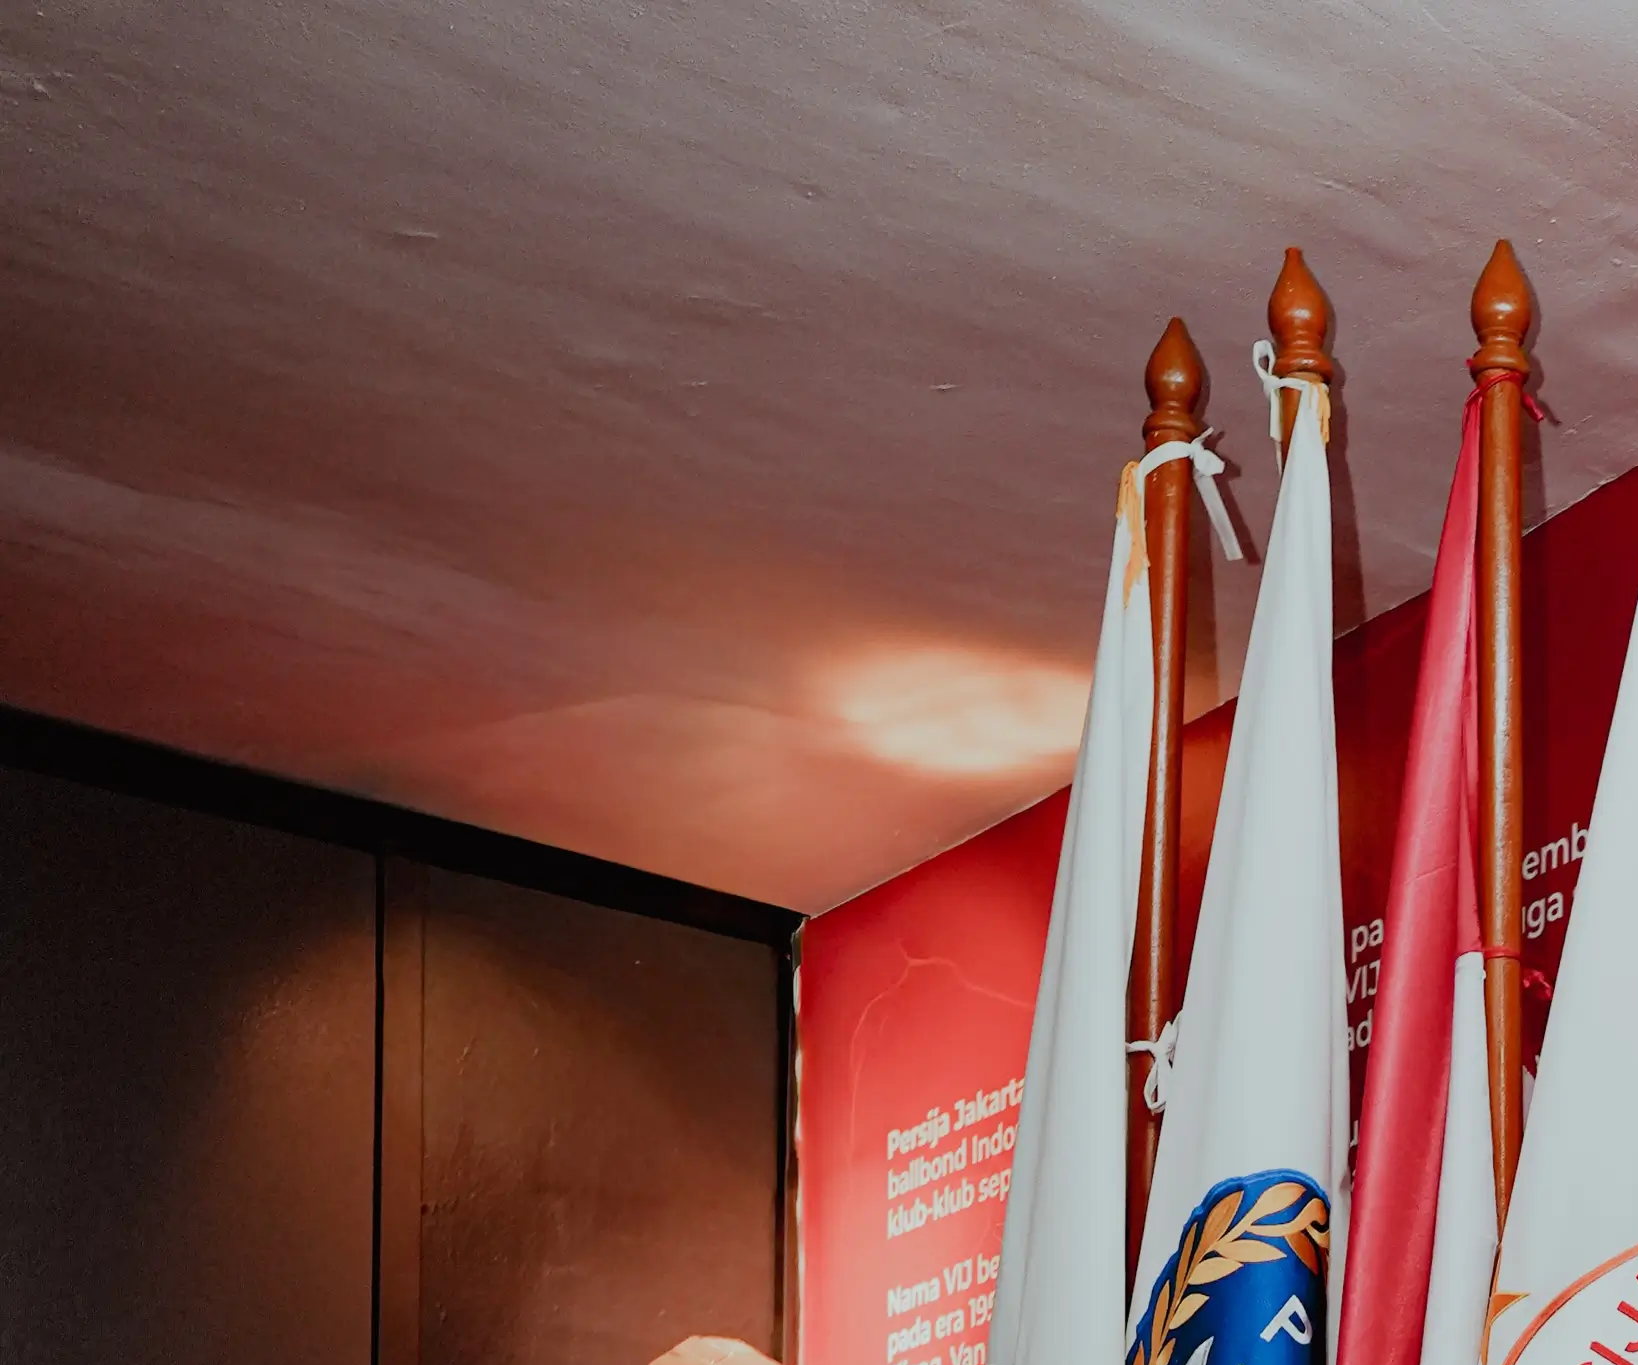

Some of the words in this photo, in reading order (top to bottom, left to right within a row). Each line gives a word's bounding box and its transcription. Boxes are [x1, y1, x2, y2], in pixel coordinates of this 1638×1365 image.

[887, 1107, 950, 1161] Persija
[888, 1137, 967, 1200] ballbond
[972, 1122, 1019, 1165] Indo
[887, 1177, 975, 1240] klub-klub
[887, 1276, 941, 1318] Nama
[887, 1316, 931, 1364] pada
[935, 1308, 965, 1340] era
